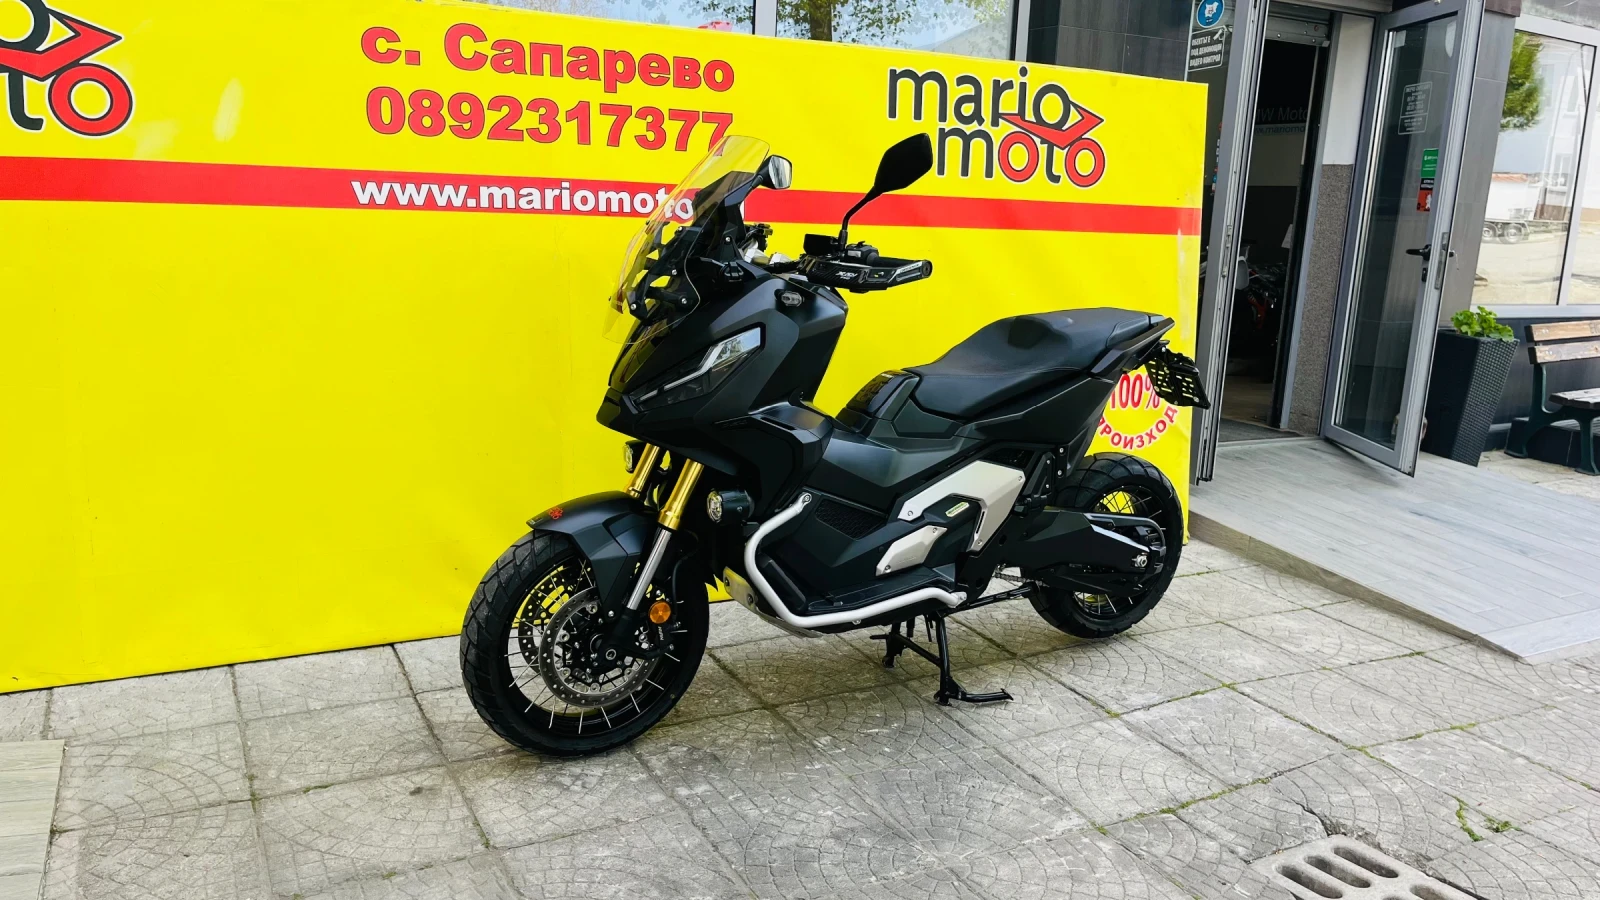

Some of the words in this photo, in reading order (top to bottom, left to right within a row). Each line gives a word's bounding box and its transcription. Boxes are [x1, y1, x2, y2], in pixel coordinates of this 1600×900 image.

[361, 26, 420, 65] с.
[444, 23, 734, 93] Сапарево
[366, 86, 733, 155] 0892317377
[888, 66, 1072, 131] mario
[937, 127, 1105, 187] moto
